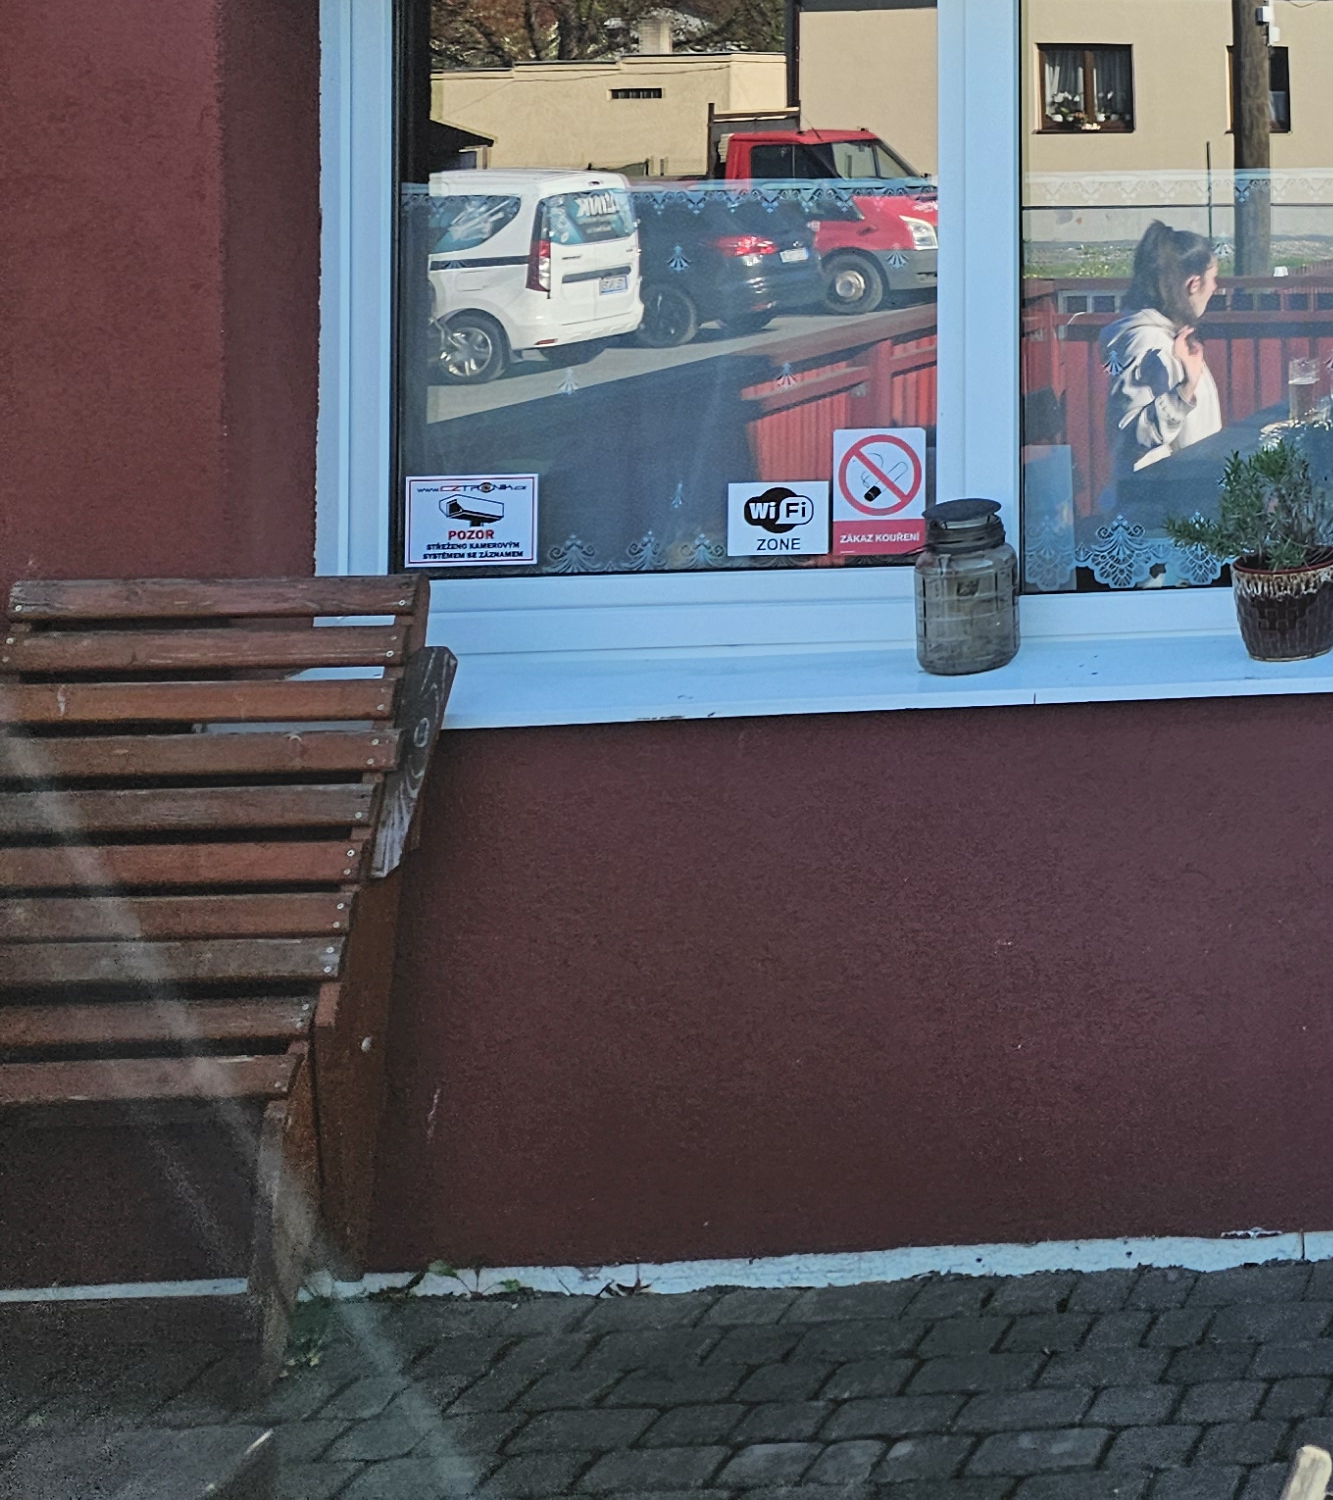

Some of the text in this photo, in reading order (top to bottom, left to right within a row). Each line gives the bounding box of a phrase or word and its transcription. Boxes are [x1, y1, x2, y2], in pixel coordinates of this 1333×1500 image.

[448, 529, 495, 540] POZOR
[840, 531, 920, 544] ZÁKAZ KOUŘENÍ
[757, 538, 801, 551] ZONE
